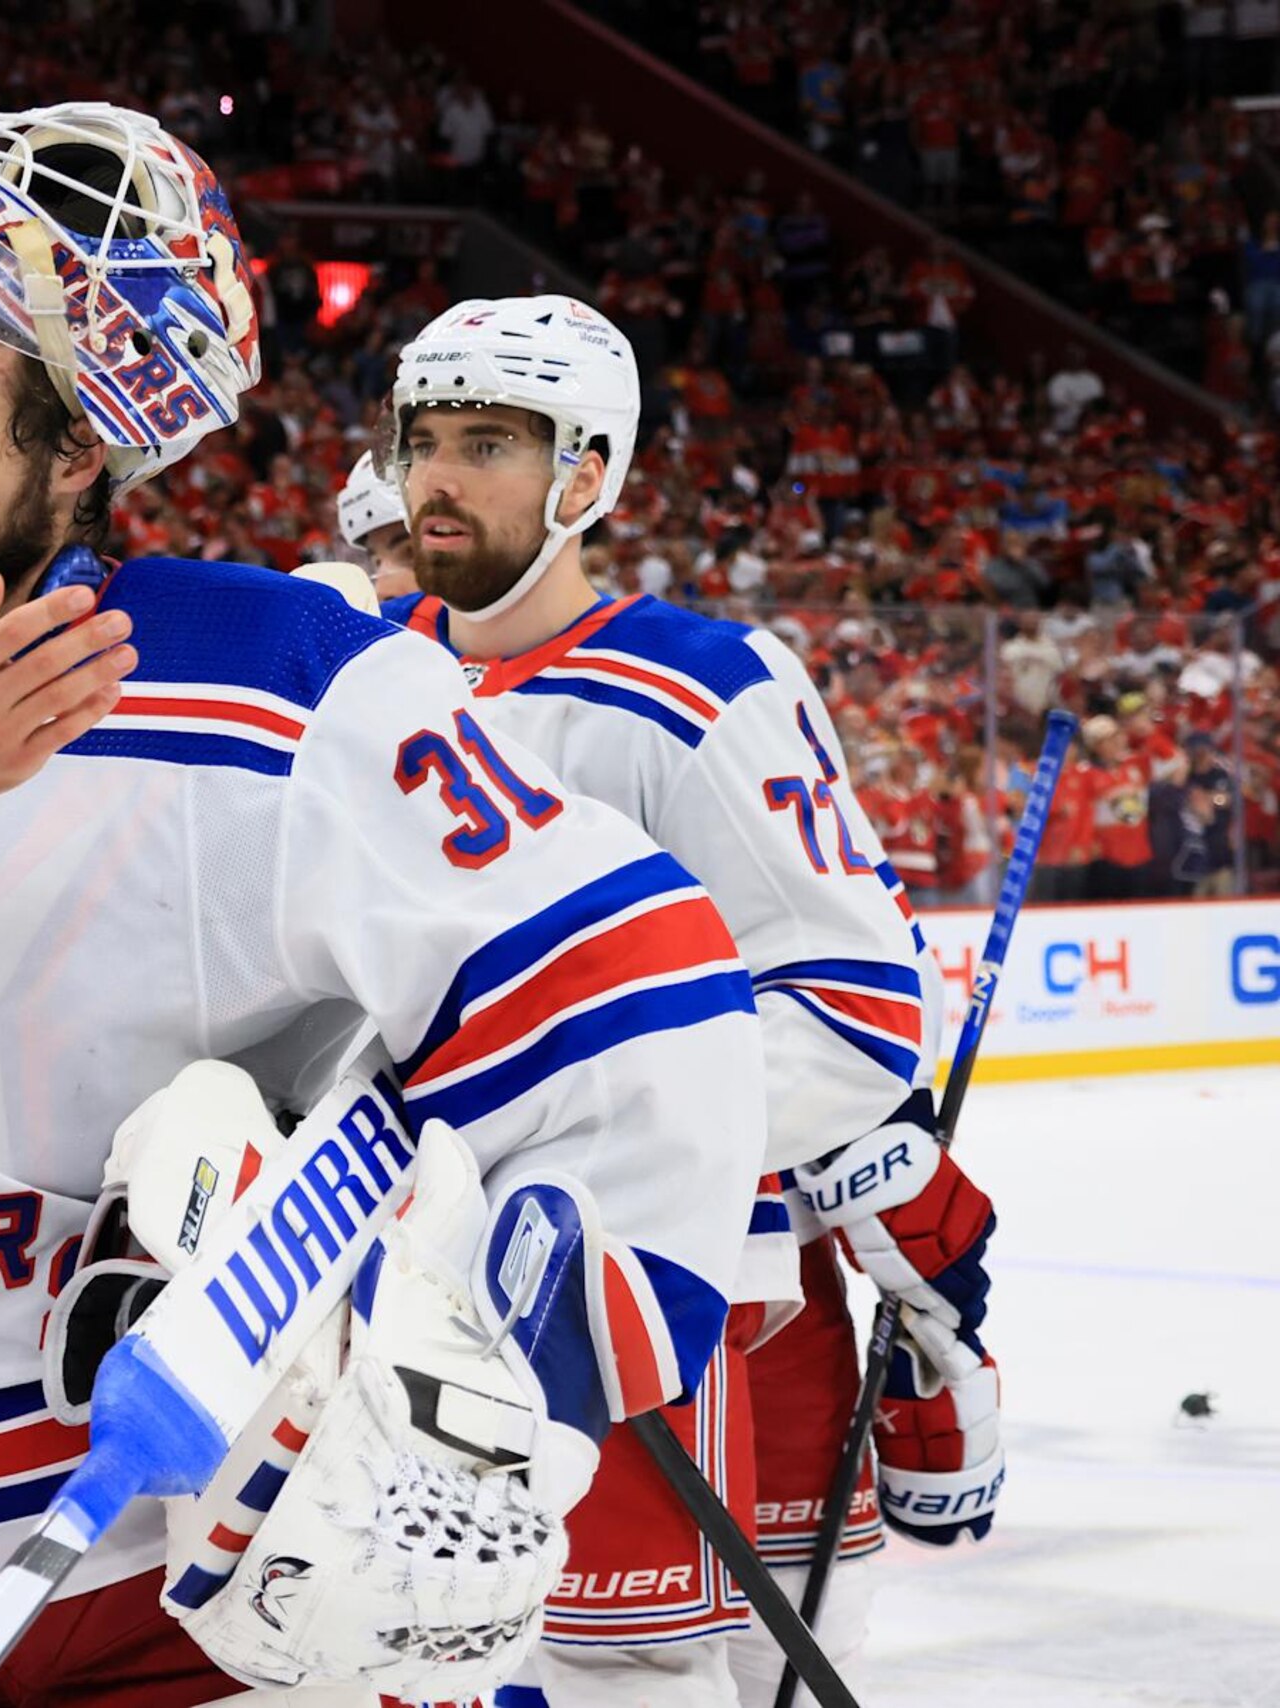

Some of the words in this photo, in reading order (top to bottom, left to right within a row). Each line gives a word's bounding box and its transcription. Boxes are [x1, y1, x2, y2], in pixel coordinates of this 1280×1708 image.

[393, 707, 565, 871] 31
[762, 775, 875, 876] 72
[1045, 939, 1129, 995] CH
[549, 1564, 694, 1600] AUER
